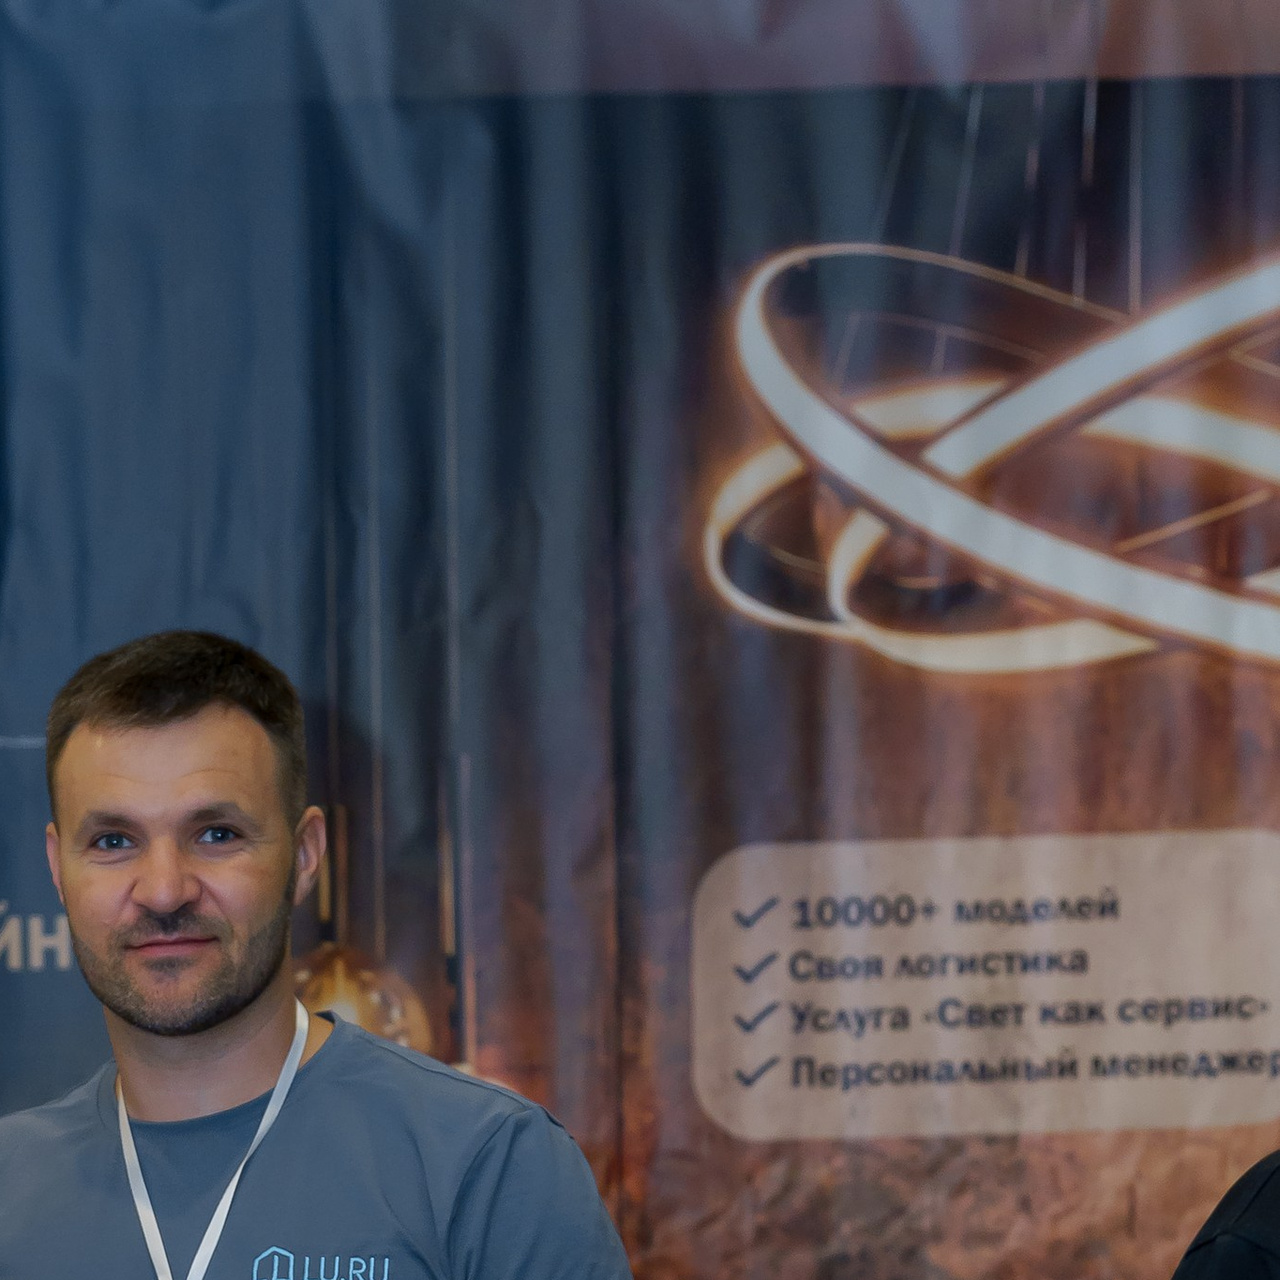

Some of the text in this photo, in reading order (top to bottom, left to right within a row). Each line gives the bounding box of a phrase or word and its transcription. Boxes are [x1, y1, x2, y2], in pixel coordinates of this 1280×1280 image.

[793, 886, 1119, 929] 10000+ моделей
[789, 945, 1088, 982] Своя логистика
[790, 1001, 910, 1039] Услуга
[1040, 1001, 1104, 1026] как
[791, 1046, 1077, 1091] Персональный
